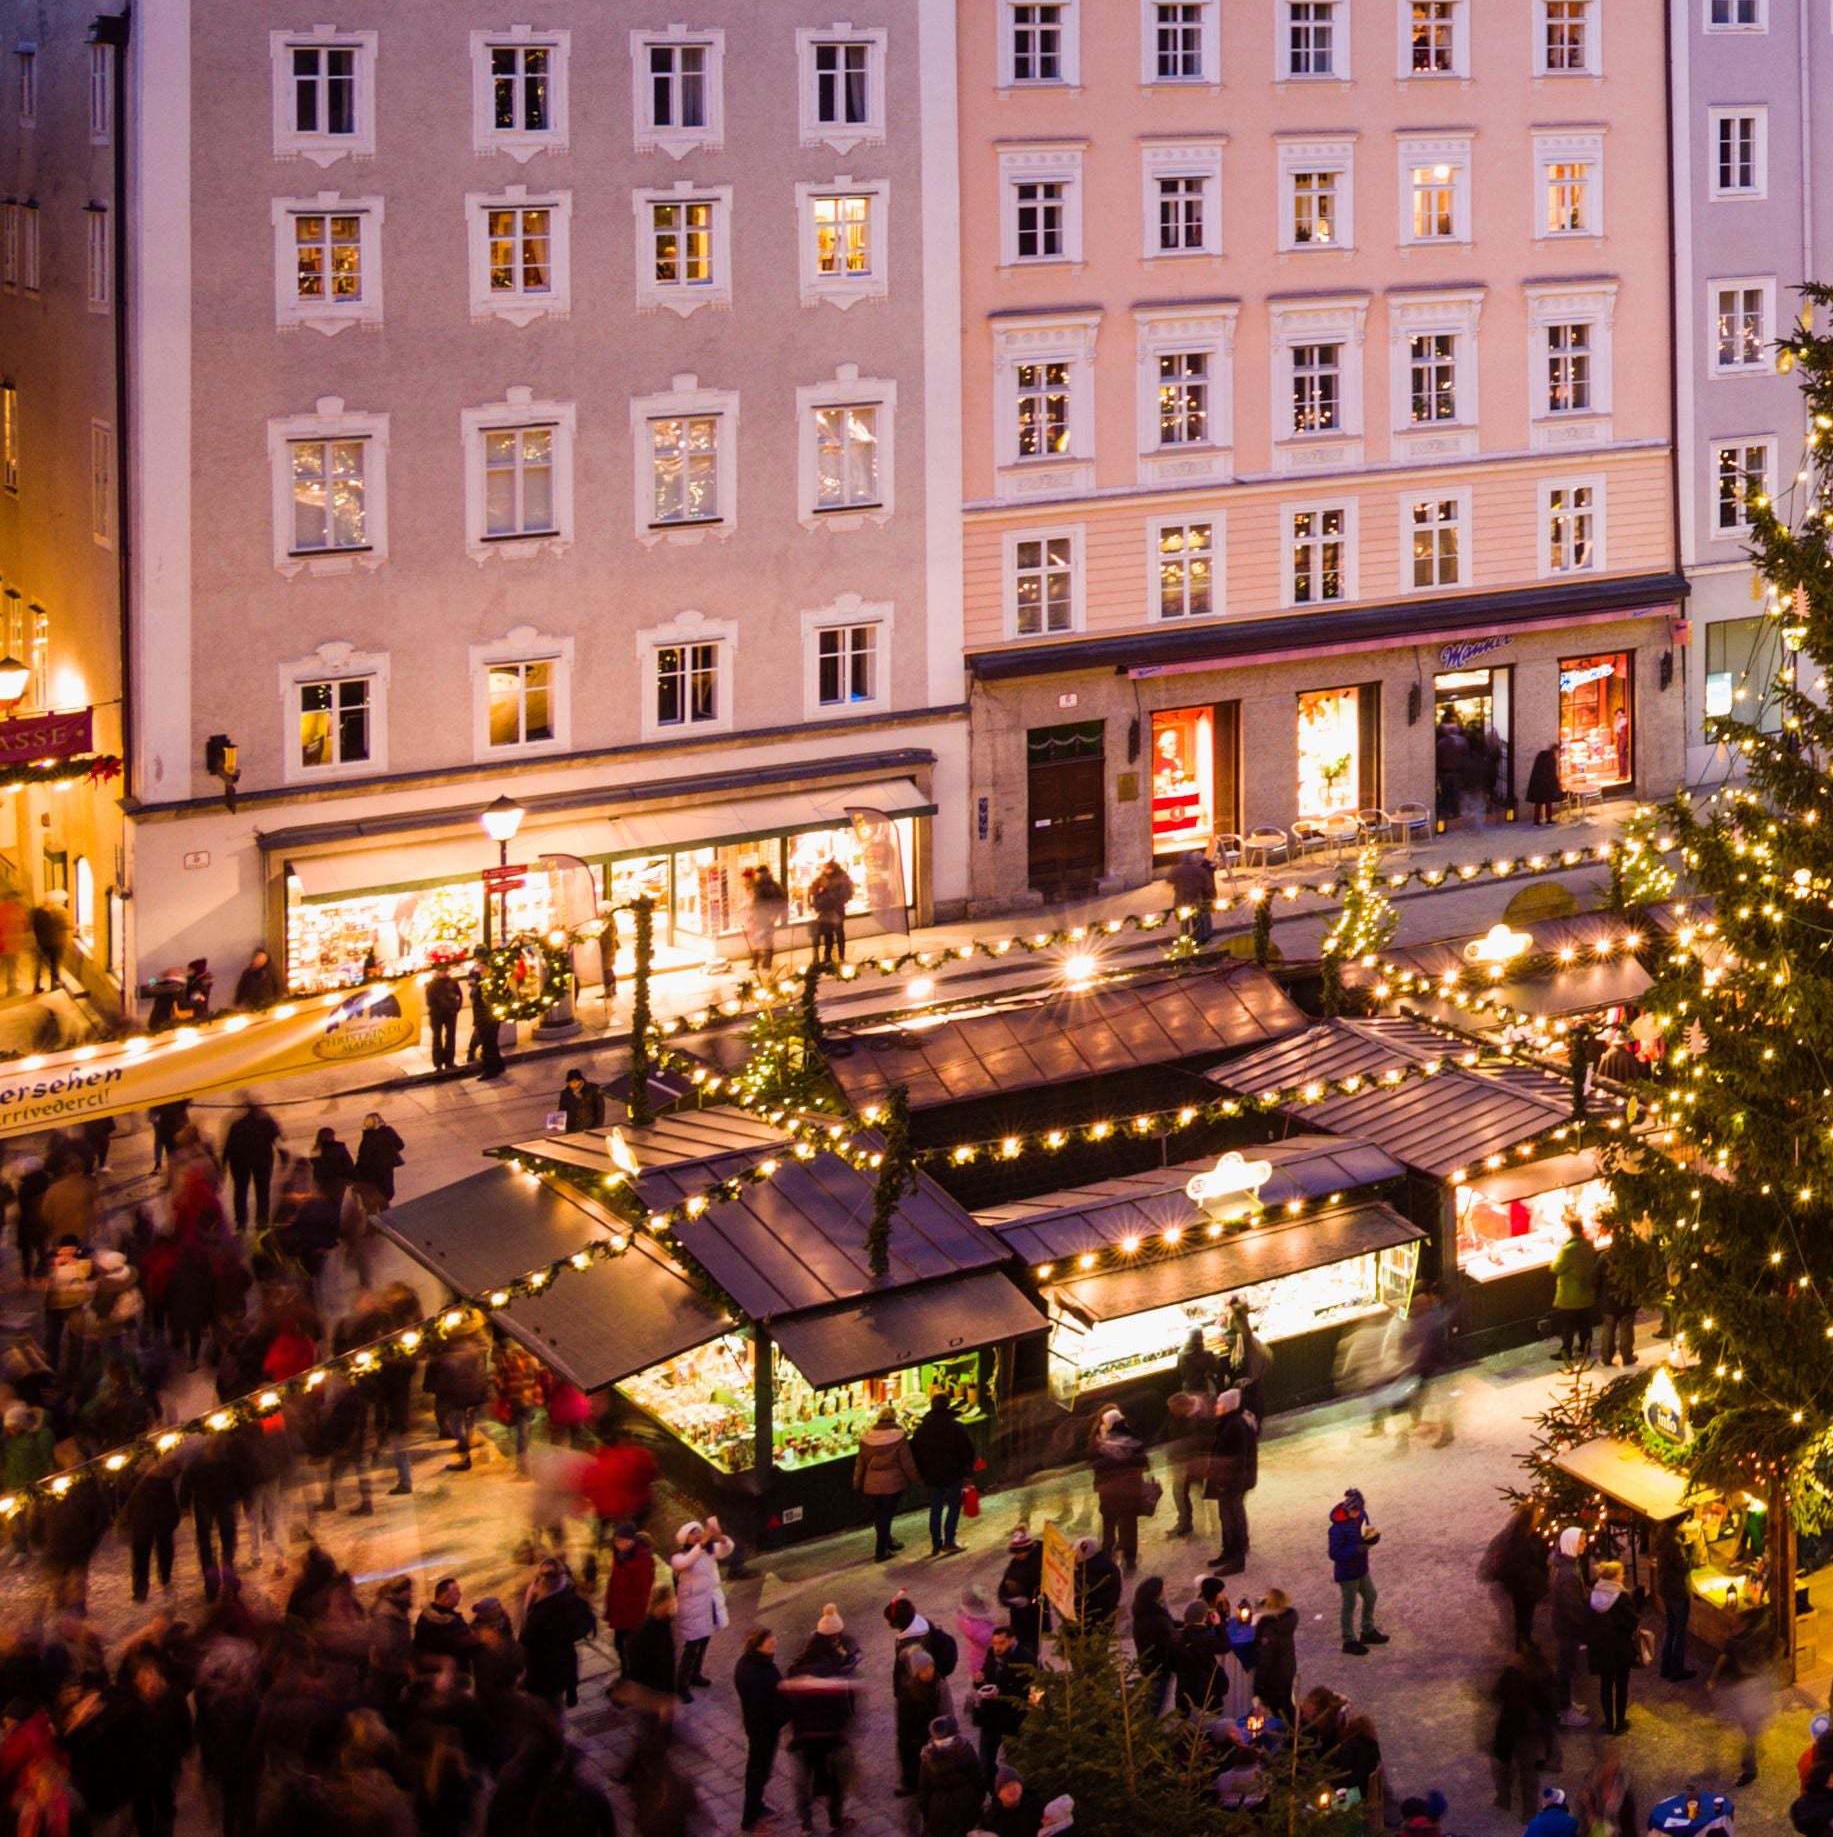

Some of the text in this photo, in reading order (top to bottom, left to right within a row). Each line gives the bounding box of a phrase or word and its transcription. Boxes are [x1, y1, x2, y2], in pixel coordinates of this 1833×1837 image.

[1440, 634, 1515, 670] Manner
[0, 1067, 122, 1104] ersehen
[1657, 1408, 1678, 1433] info
